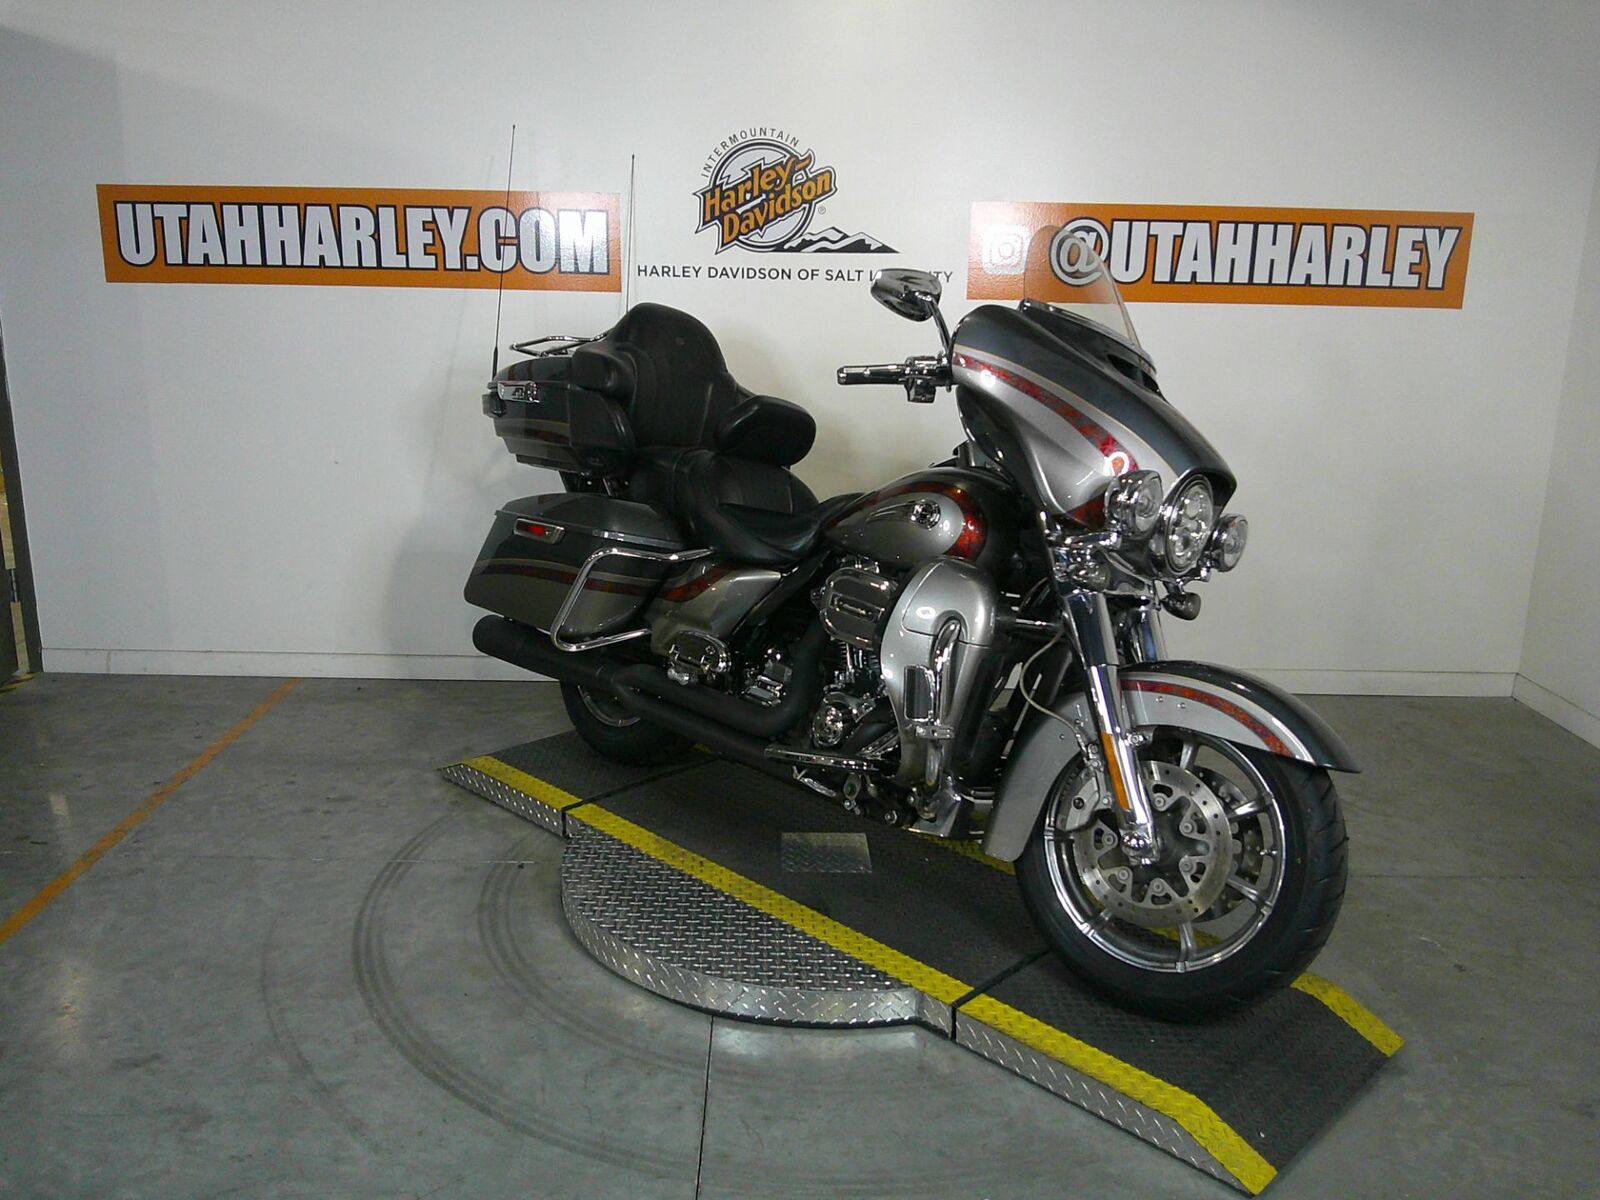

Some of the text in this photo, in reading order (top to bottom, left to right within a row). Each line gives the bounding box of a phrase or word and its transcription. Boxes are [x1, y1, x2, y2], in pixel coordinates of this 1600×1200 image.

[701, 127, 800, 178] INTERMOUNTAIN
[113, 200, 610, 276] UTAHHARLEY.COM
[722, 170, 832, 245] Davidson
[637, 265, 702, 278] HARLEY
[707, 266, 792, 281] DAVIDSON
[797, 268, 820, 281] OF
[824, 269, 864, 282] SALT
[1049, 216, 1462, 291] @UTAHHARLEY
